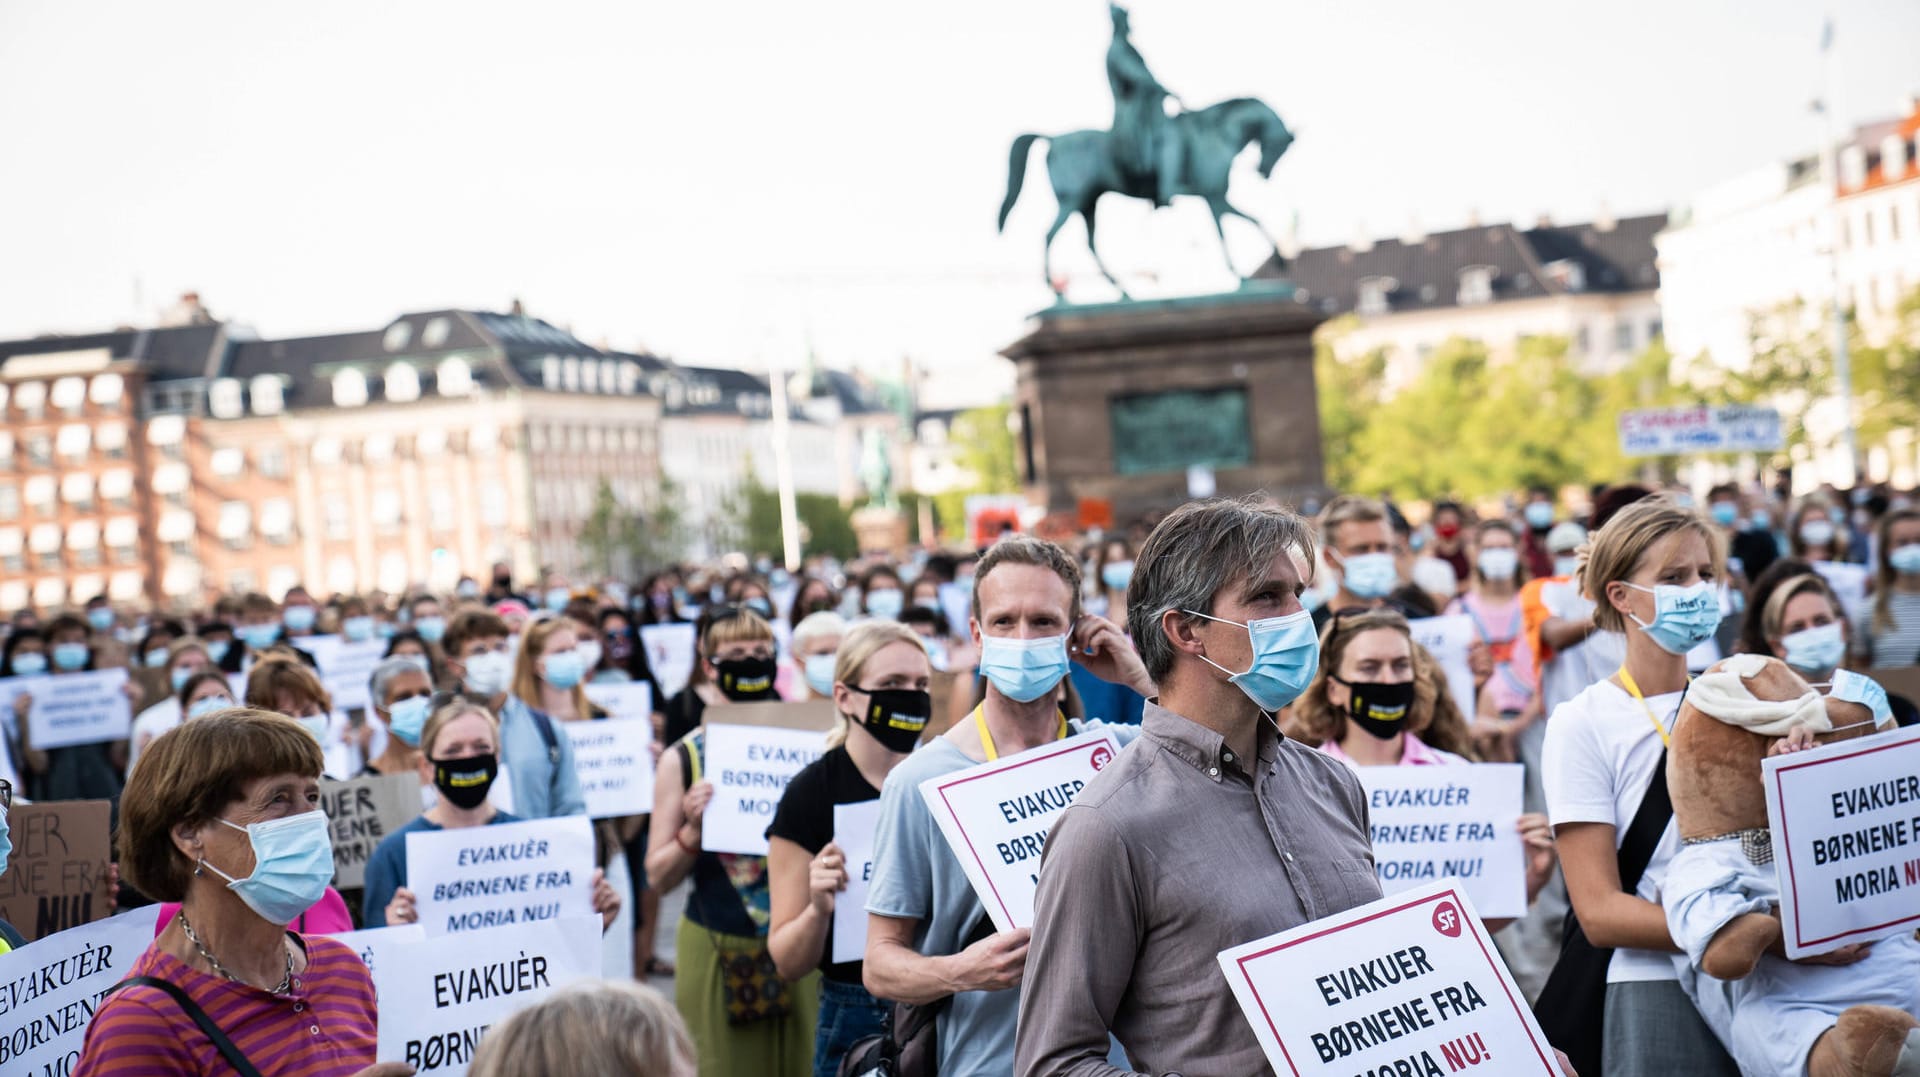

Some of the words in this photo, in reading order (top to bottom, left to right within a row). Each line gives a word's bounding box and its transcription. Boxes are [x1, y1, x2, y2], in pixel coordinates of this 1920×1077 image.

[1371, 784, 1470, 808] EVAKUÈR
[1831, 775, 1920, 819] EVAKUER
[1456, 822, 1496, 843] FRA
[1812, 819, 1908, 866] BØRNENE
[457, 839, 549, 867] EVAKUÈR
[1442, 858, 1483, 879] NU!
[432, 876, 531, 902] BØRNENE
[535, 870, 573, 891] FRA
[1835, 865, 1900, 904] MORIA
[447, 908, 517, 933] MORIA
[521, 902, 561, 923] NU!
[1437, 909, 1456, 931] SF
[434, 951, 551, 1009] EVAKUÈR
[1315, 945, 1434, 1006] EVAKUER
[1310, 999, 1435, 1064] BØRNENE
[1432, 981, 1487, 1022] FRA
[1440, 1032, 1491, 1073] NU!
